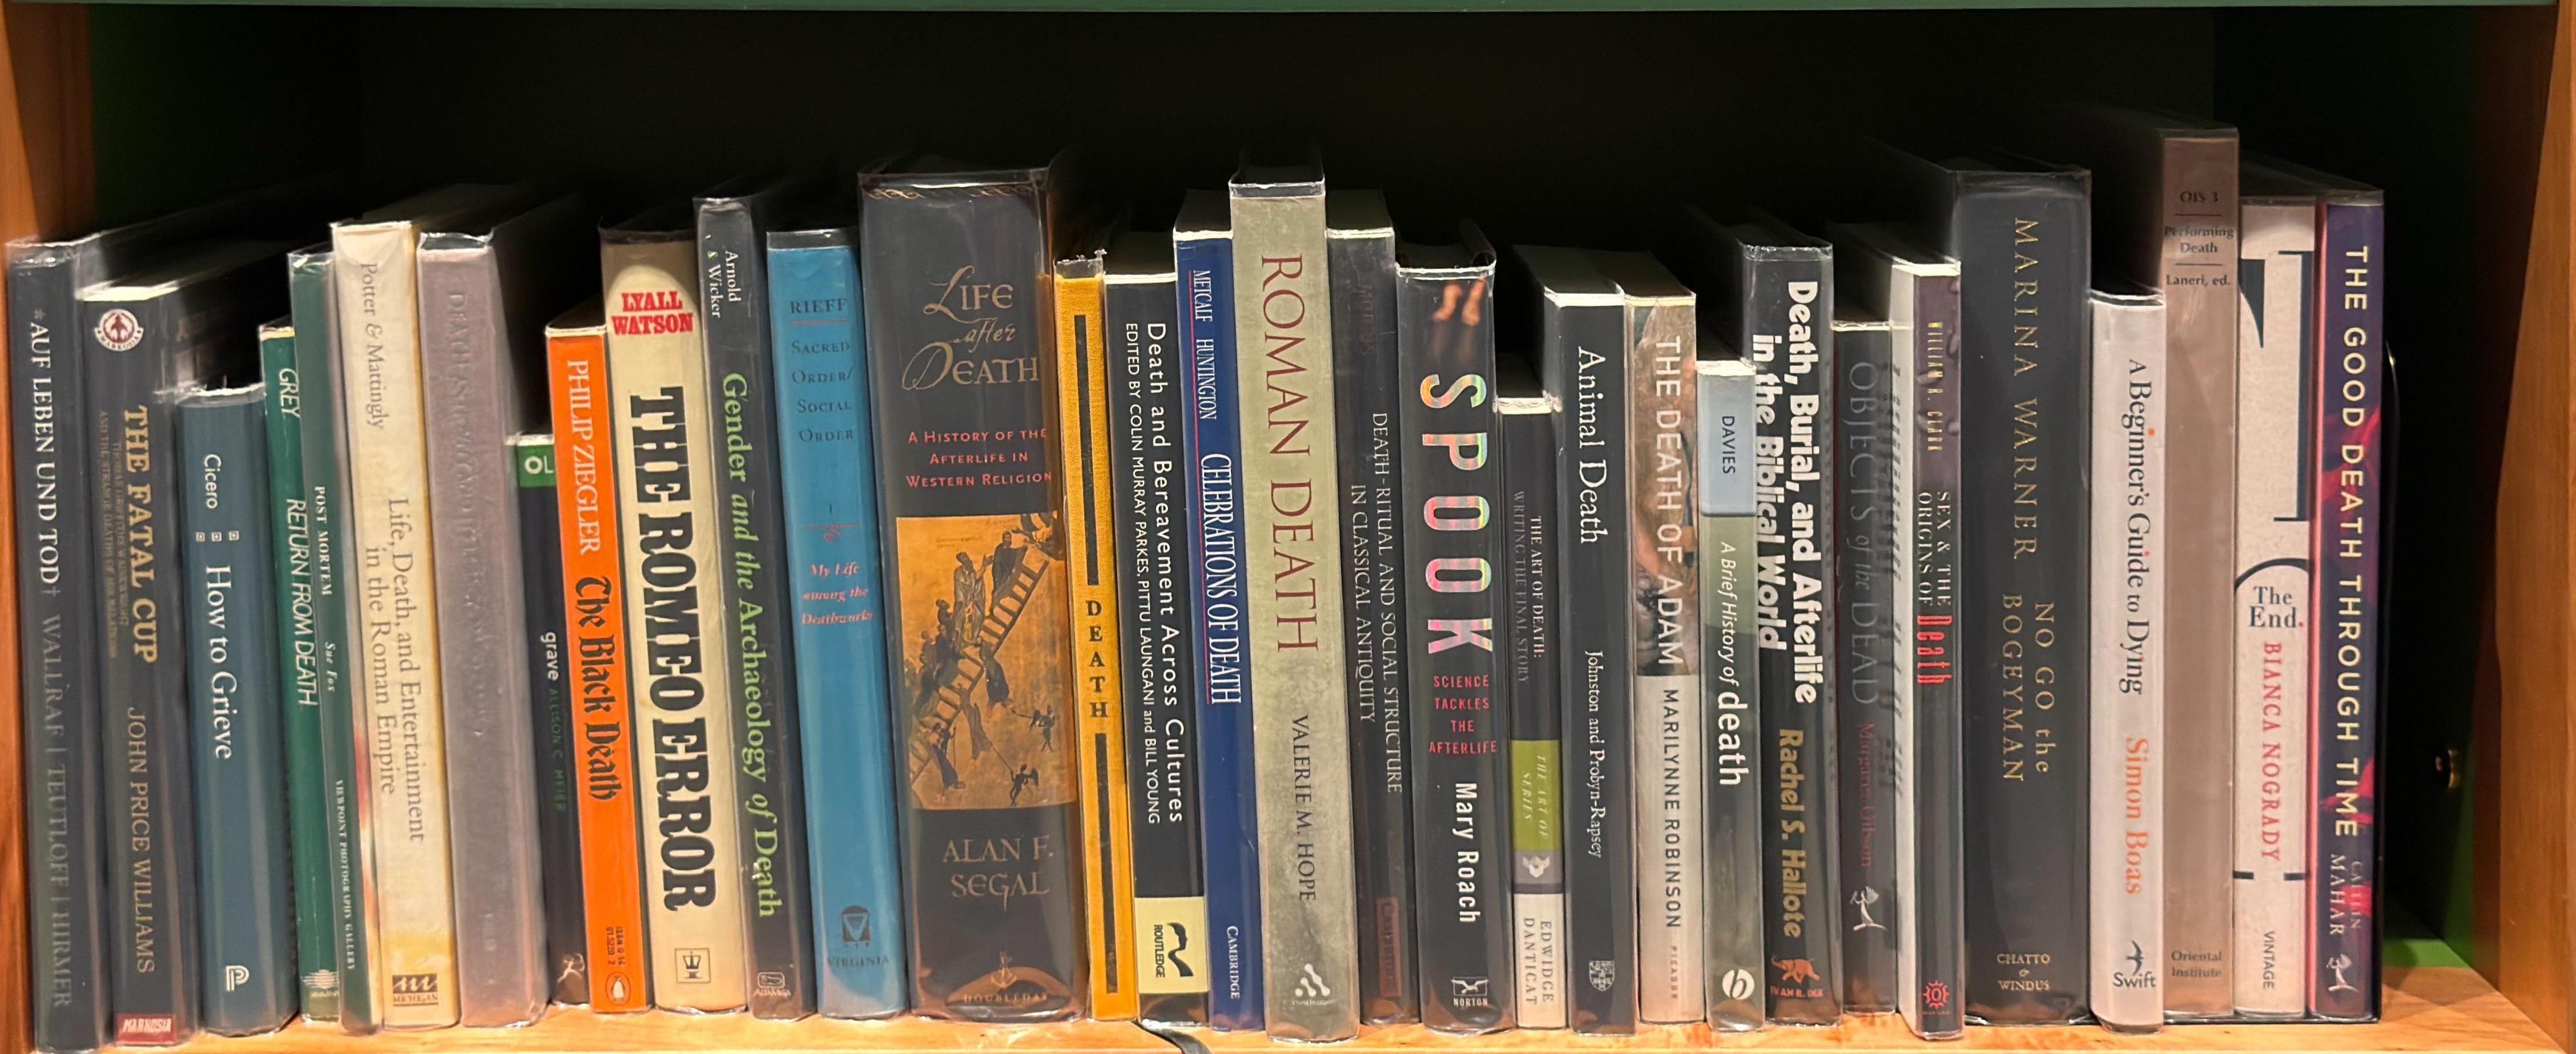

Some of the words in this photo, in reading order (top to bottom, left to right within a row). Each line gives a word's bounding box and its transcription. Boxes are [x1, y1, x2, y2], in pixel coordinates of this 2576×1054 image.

[2165, 225, 2234, 239] Performing
[2180, 242, 2218, 253] Death
[359, 263, 379, 315] Potter
[622, 290, 683, 312] LYALL
[708, 265, 723, 318] Wicker
[725, 251, 742, 301] Arnold
[1193, 270, 1213, 322] METCALF
[2014, 218, 2039, 377] MARINA
[2212, 274, 2231, 286] ed.
[2345, 246, 2369, 310] THE
[365, 324, 381, 338] &
[611, 312, 693, 335] WATSON
[790, 298, 848, 314] RIEFF
[1784, 281, 1819, 385] Death,
[30, 322, 52, 369] AUF
[951, 317, 1017, 353] after
[1126, 324, 1140, 375] EDITED
[1148, 324, 1168, 393] Death
[1262, 253, 1311, 457] ROMAN
[1927, 322, 1943, 378] WILLIAM
[279, 369, 301, 418] GREY
[365, 344, 389, 430] Mattingly
[901, 342, 1040, 390] DEATH
[1129, 381, 1141, 398] BY
[1196, 338, 1217, 419] HUNTINGTON
[2130, 360, 2147, 374] A
[2342, 328, 2366, 426] GOOD
[33, 378, 55, 453] LEBEN
[567, 360, 594, 441] PHILIP
[1578, 346, 1606, 450] Animal
[908, 431, 917, 443] A
[924, 431, 989, 443] HISTORY
[995, 431, 1013, 441] OF
[1020, 428, 1047, 439] THE
[1130, 405, 1143, 450] COLIN
[1152, 406, 1172, 446] and
[1722, 416, 1736, 474] DAVIES
[1786, 395, 1821, 491] Burial,
[1927, 411, 1943, 451] CLARK
[2122, 382, 2155, 506] Beginner's
[205, 454, 221, 508] Cicero
[906, 475, 975, 487] WESTERN
[982, 471, 1052, 486] RELIGION
[929, 453, 1006, 465] AFTERLIFE
[1013, 452, 1028, 462] IN
[2014, 397, 2039, 560] WARNER
[36, 463, 57, 521] UND
[313, 486, 328, 523] POST
[572, 445, 601, 555] ZIEGLER
[1132, 457, 1146, 516] MURRAY
[1420, 374, 1494, 654] SPOOK
[1579, 459, 1608, 544] Death
[1937, 492, 1951, 530] SEX
[2340, 445, 2364, 558] DEATH
[1153, 461, 1176, 615] Bereavement
[1514, 491, 1527, 553] WRITING
[1530, 516, 1543, 544] THE
[1792, 502, 1821, 560] and
[1918, 492, 1933, 574] ORIGINS
[1937, 541, 1951, 552] &
[38, 529, 59, 584] TOD
[317, 530, 332, 596] MORTEM
[366, 548, 382, 568] in
[1271, 478, 1318, 653] DEATH
[1515, 558, 1527, 587] THE
[1531, 550, 1543, 576] ART
[2128, 514, 2151, 588] Guide
[206, 564, 232, 628] How
[368, 576, 390, 612] the
[574, 576, 612, 627] The
[1138, 581, 1151, 621] PITTU
[1378, 563, 1395, 605] AND
[1532, 581, 1544, 600] OF
[1918, 582, 1933, 606] OF
[1937, 564, 1951, 606] THE
[2127, 595, 2143, 612] to
[2253, 585, 2292, 606] The
[1516, 592, 1528, 633] FINAL
[1532, 605, 1545, 657] DEATH:
[1793, 573, 1823, 703] Afterlife
[2248, 605, 2304, 629] End.
[210, 636, 229, 663] to
[371, 621, 392, 704] Roman
[1086, 600, 1109, 717] DEATH
[1140, 628, 1154, 705] LAUNGANI
[1161, 625, 1180, 706] Across
[1380, 612, 1398, 680] SOCIAL
[1517, 638, 1530, 684] STORY
[1917, 615, 1953, 684] Death
[2119, 620, 2150, 694] Dying
[2337, 575, 2361, 740] THROUGH
[44, 614, 65, 736] WALLRAF
[578, 637, 616, 713] Black
[1433, 675, 1489, 688] SCIENCE
[1584, 649, 1604, 712] Johnston
[2262, 642, 2282, 732] BIANCA
[211, 672, 238, 760] Grieve
[1144, 710, 1156, 732] and
[1434, 697, 1489, 710] TACKLES
[1451, 720, 1475, 733] THE
[1589, 718, 1604, 744] and
[373, 713, 399, 793] Empire
[585, 722, 622, 799] Death
[1144, 738, 1157, 766] BILL
[1293, 714, 1312, 802] VALERIE
[1384, 686, 1402, 793] STRUCTURE
[1429, 741, 1497, 754] AFTERLIFE
[1664, 690, 1680, 810] MARILYNNE
[1146, 769, 1161, 823] YOUNG
[1165, 719, 1185, 822] Cultures
[2124, 737, 2150, 819] Simon
[2335, 758, 2359, 837] TIME
[1295, 810, 1313, 834] M.
[1452, 783, 1477, 839] Mary
[1587, 749, 1606, 858] Probyn-Rapsey
[2261, 743, 2281, 861] NOGRADY
[943, 838, 1021, 862] ALAN
[1033, 835, 1054, 860] F.
[1297, 843, 1316, 900] HOPE
[1665, 819, 1681, 927] ROBINSON
[2124, 830, 2150, 894] Boas
[951, 872, 1050, 912] SEGAL
[1456, 851, 1481, 922] Roach
[2329, 854, 2348, 935] MAHAR
[52, 911, 71, 1007] HIRMER
[1153, 924, 1166, 978] ROUTLEDGE
[1226, 926, 1240, 999] CAMBRIDGE
[1523, 917, 1538, 1005] DANTICAT
[1540, 920, 1554, 1003] EDWIDGE
[1997, 954, 2051, 964] CHATTO
[2171, 950, 2223, 962] Oriental
[2171, 967, 2223, 978] Institute
[2263, 930, 2275, 990] VINTAGE
[964, 993, 1048, 1003] DOUBLEDAY
[1454, 997, 1488, 1007] NORTON
[1998, 980, 2051, 991] WINDUS
[2112, 971, 2156, 988] Swift
